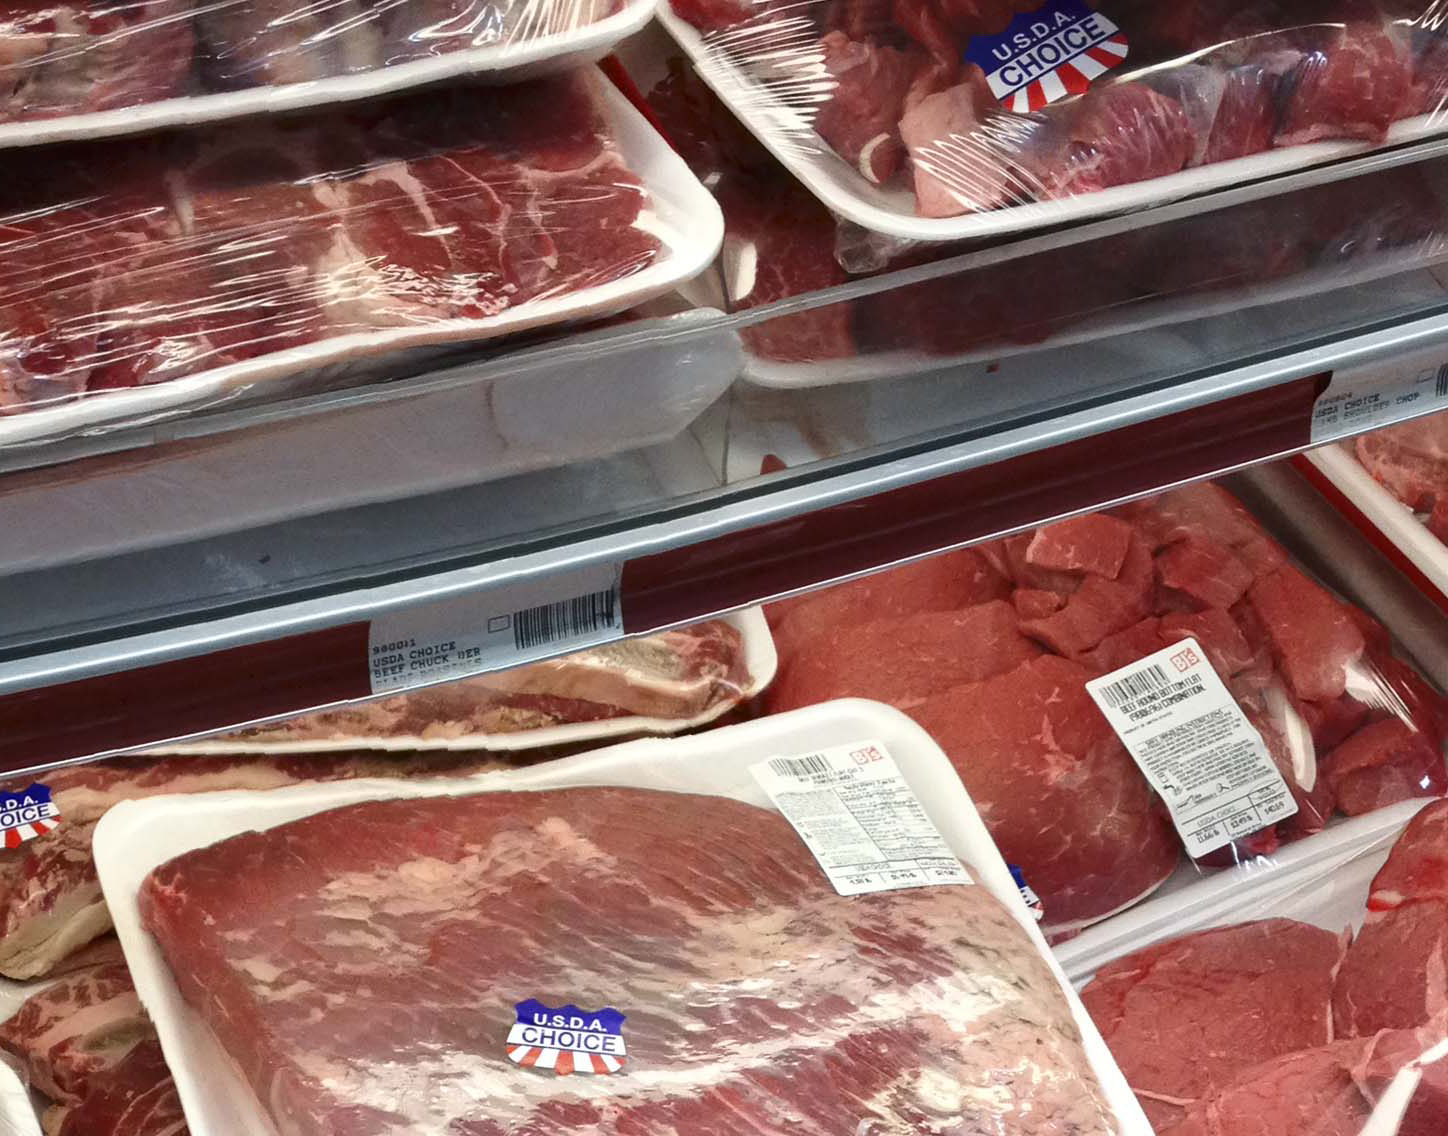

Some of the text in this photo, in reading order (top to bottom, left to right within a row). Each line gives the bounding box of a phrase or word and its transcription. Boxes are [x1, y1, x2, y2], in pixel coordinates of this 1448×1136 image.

[992, 9, 1075, 61] U.S.D.A.
[999, 16, 1105, 87] CHOICE
[373, 641, 457, 668] USDA CHOICE
[375, 663, 406, 679] BEEF
[410, 654, 449, 671] CHUCK
[533, 1013, 607, 1032] U.S.D.A.
[522, 1028, 616, 1052] CHOICE
